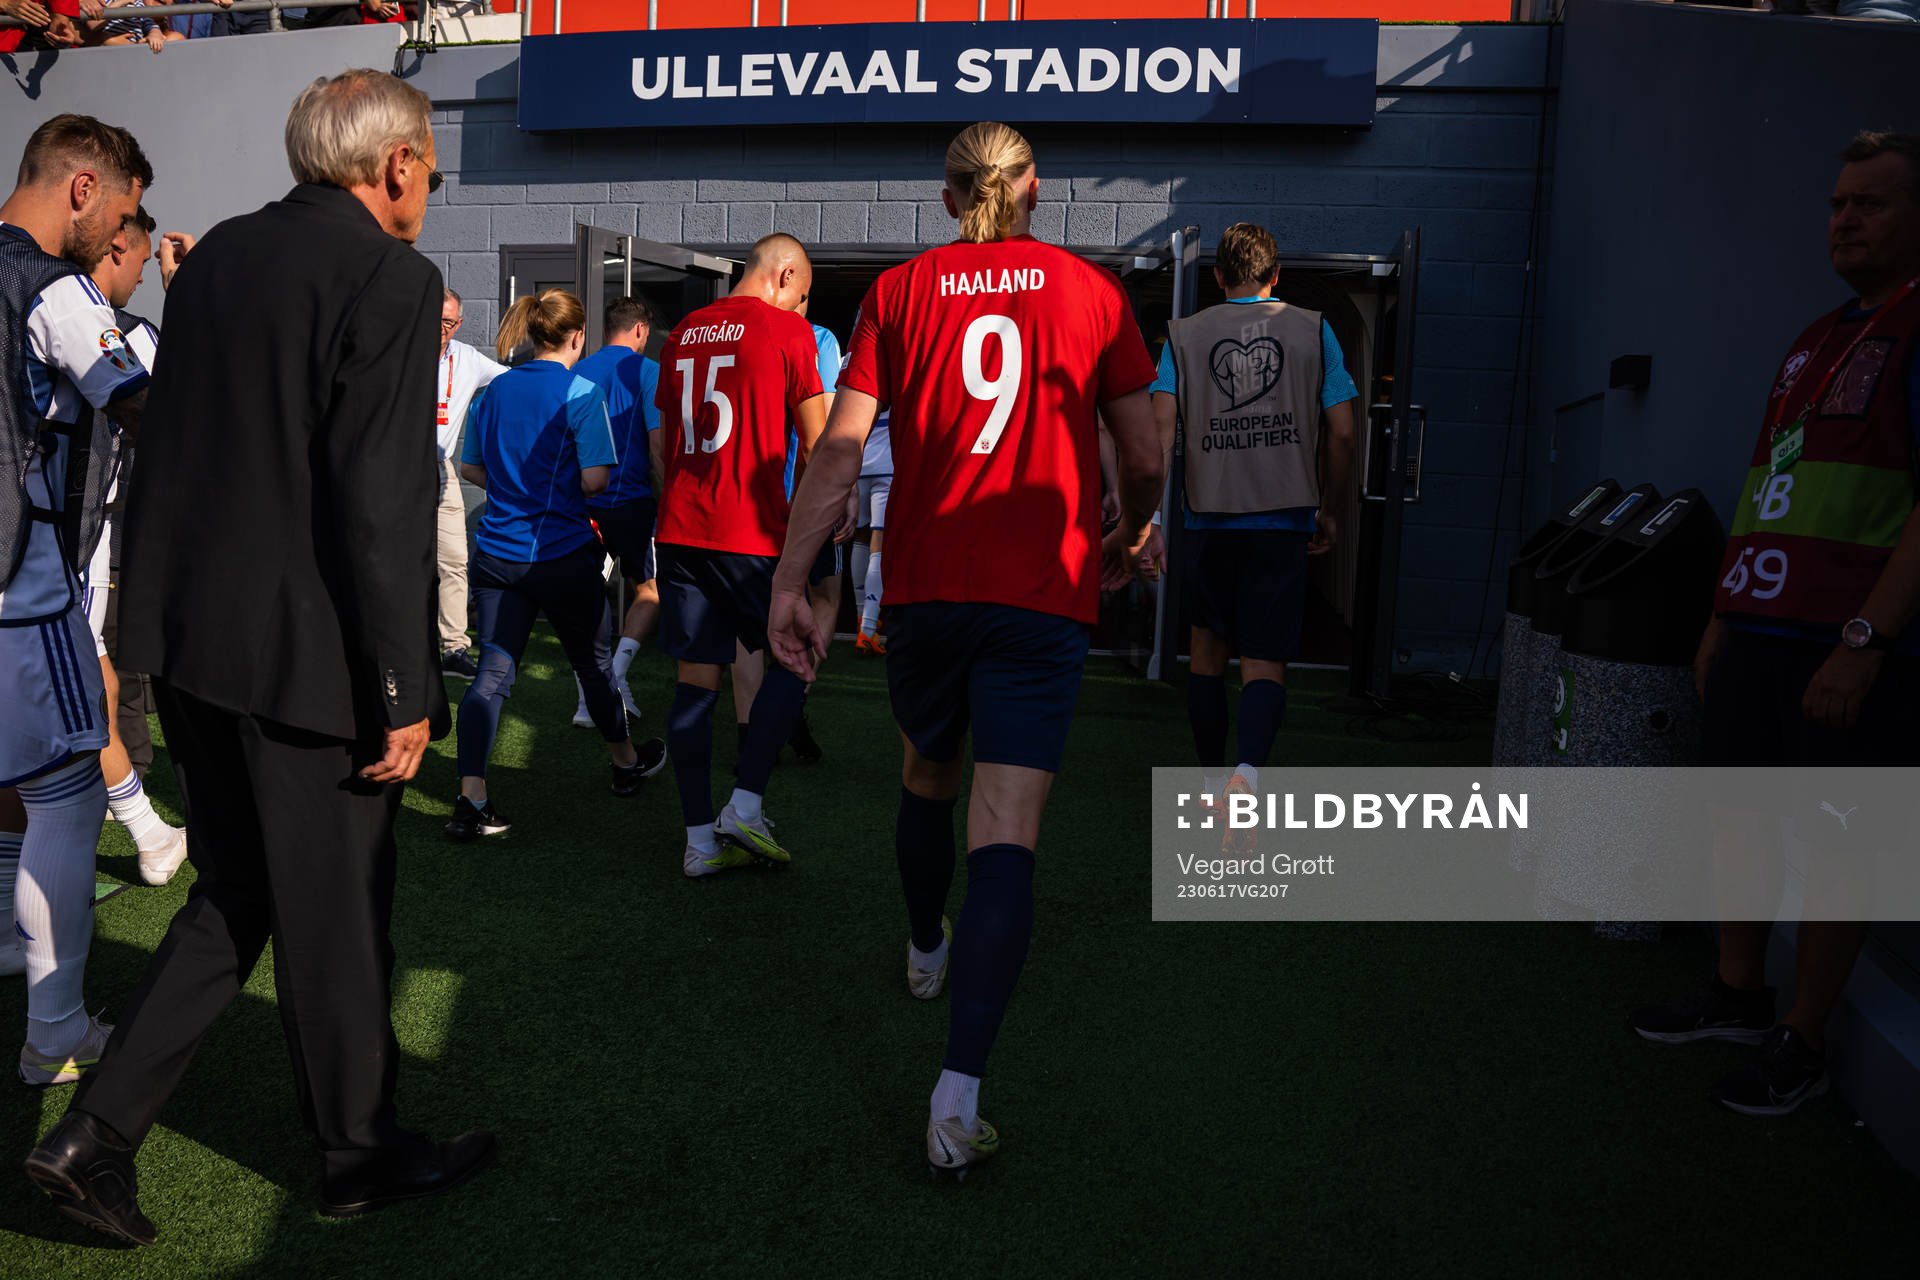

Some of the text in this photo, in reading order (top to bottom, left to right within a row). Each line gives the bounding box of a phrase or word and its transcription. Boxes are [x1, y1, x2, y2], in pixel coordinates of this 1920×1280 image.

[631, 46, 1241, 100] ULLEVAAL STADION
[940, 268, 1045, 297] HAALAND
[680, 320, 745, 346] ØSTIGÅRD
[962, 314, 1022, 455] 9
[675, 354, 736, 455] 15
[1209, 412, 1293, 432] EUROPEAN
[1201, 428, 1301, 453] QUALIFIERS
